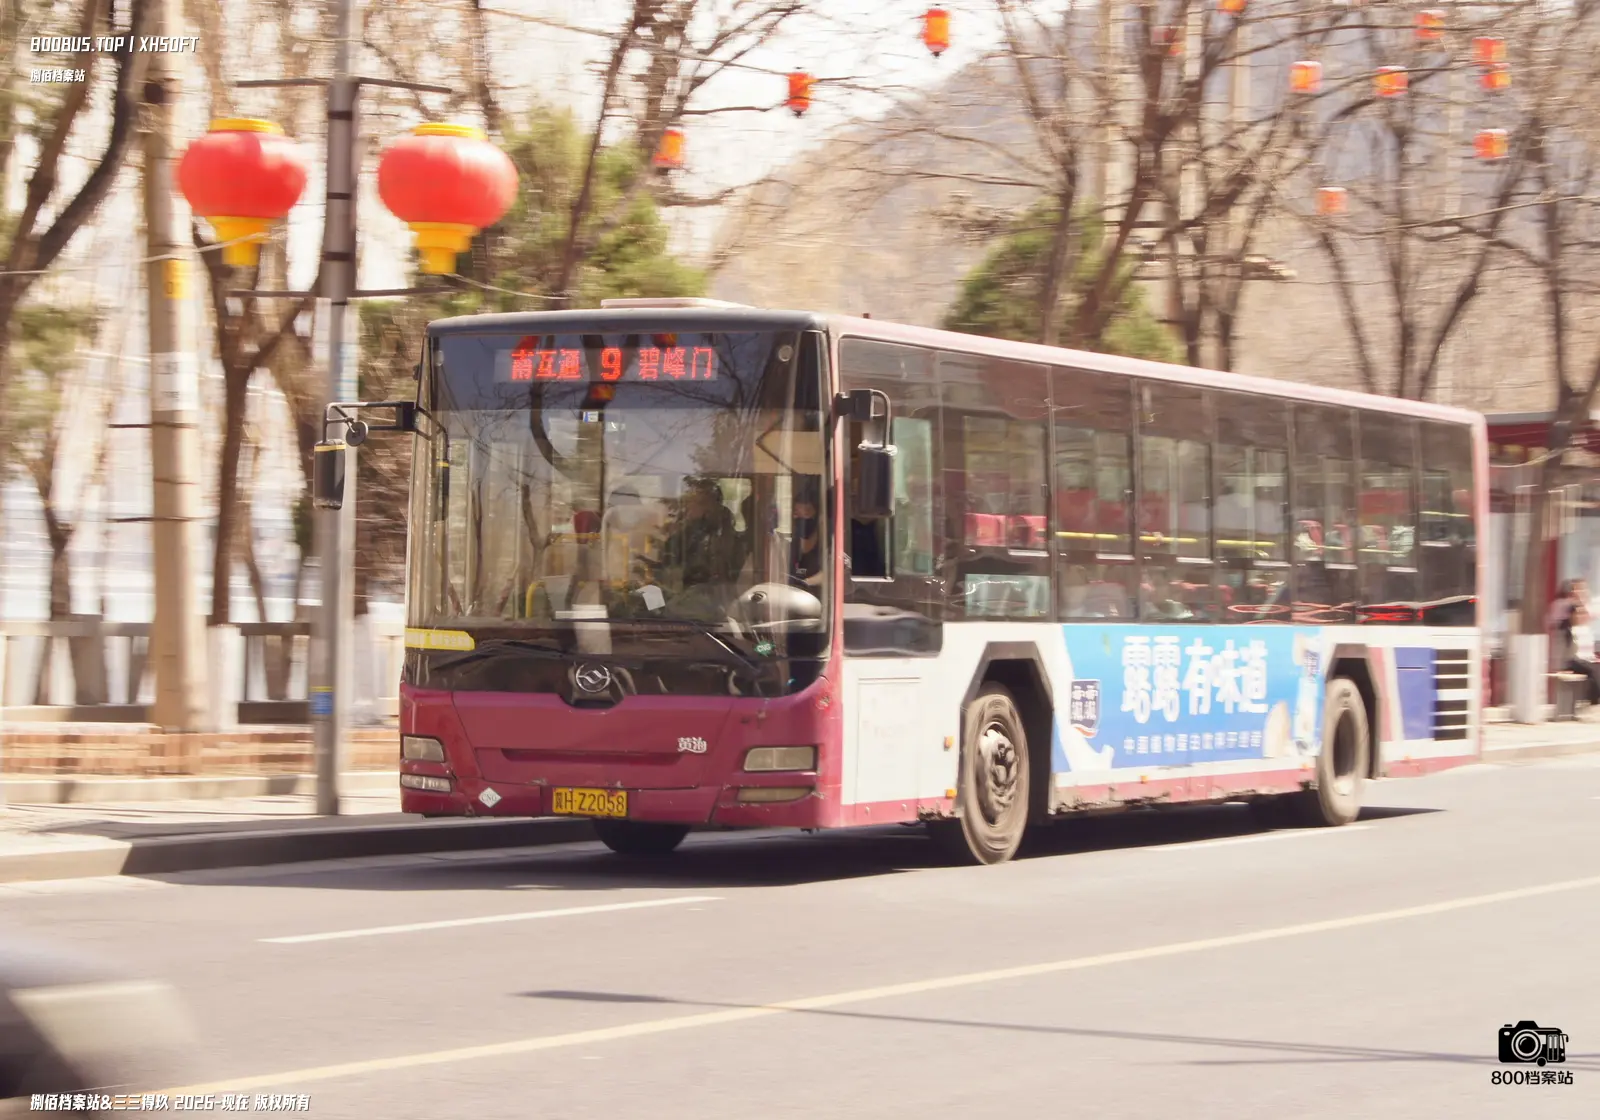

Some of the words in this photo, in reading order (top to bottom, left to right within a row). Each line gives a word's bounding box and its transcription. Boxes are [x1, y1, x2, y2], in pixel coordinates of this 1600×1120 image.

[600, 347, 622, 381] 9
[638, 347, 713, 380] 碧峰门
[756, 643, 772, 653] CNG
[1120, 635, 1269, 724] 露露有味道
[677, 736, 707, 754] 黄海
